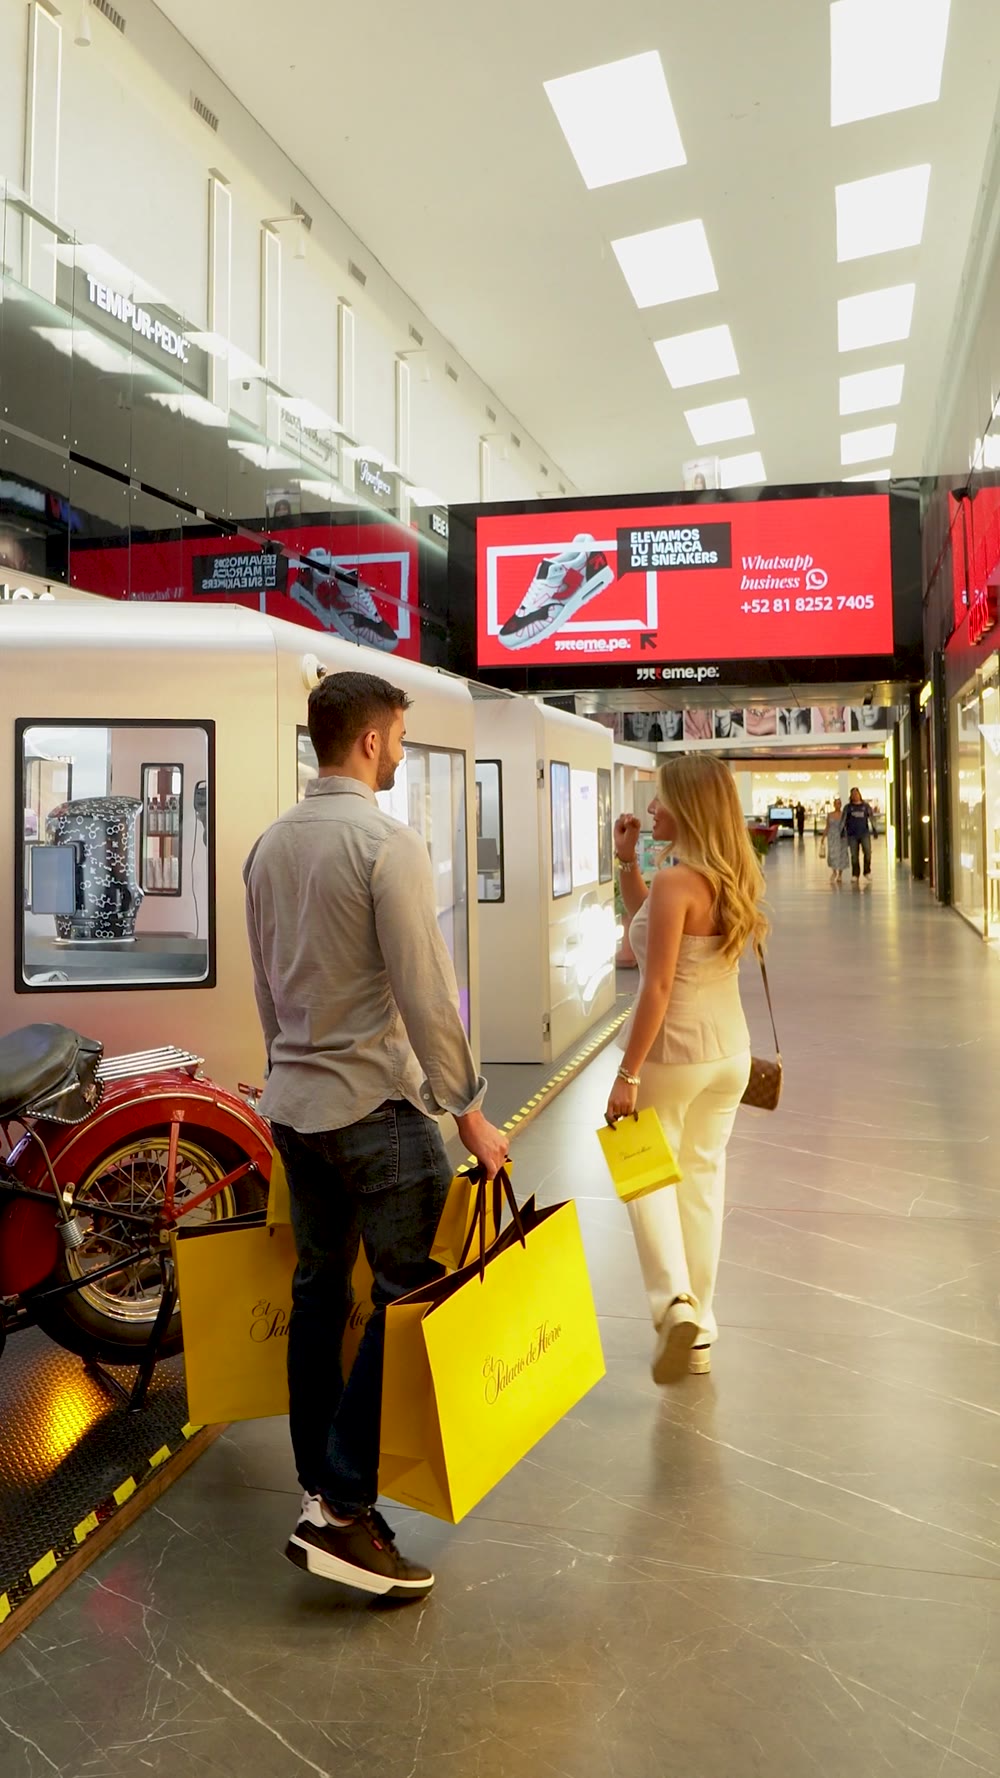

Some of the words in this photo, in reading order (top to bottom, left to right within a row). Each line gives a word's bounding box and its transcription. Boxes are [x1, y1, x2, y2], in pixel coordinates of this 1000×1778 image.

[630, 528, 700, 544] ELEVAMOS
[630, 543, 649, 555] TU
[652, 541, 702, 553] MARCA
[630, 555, 649, 567] DE
[651, 551, 718, 566] SNEAKERS
[741, 554, 814, 571] Whatsapp
[740, 575, 800, 590] business
[740, 599, 770, 614] +52
[773, 598, 791, 612] 81
[795, 596, 833, 612] 8252
[837, 595, 875, 610] 7405
[251, 1298, 271, 1317] El
[483, 1355, 494, 1378] El
[485, 1359, 525, 1405] Palacio
[526, 1342, 537, 1366] de
